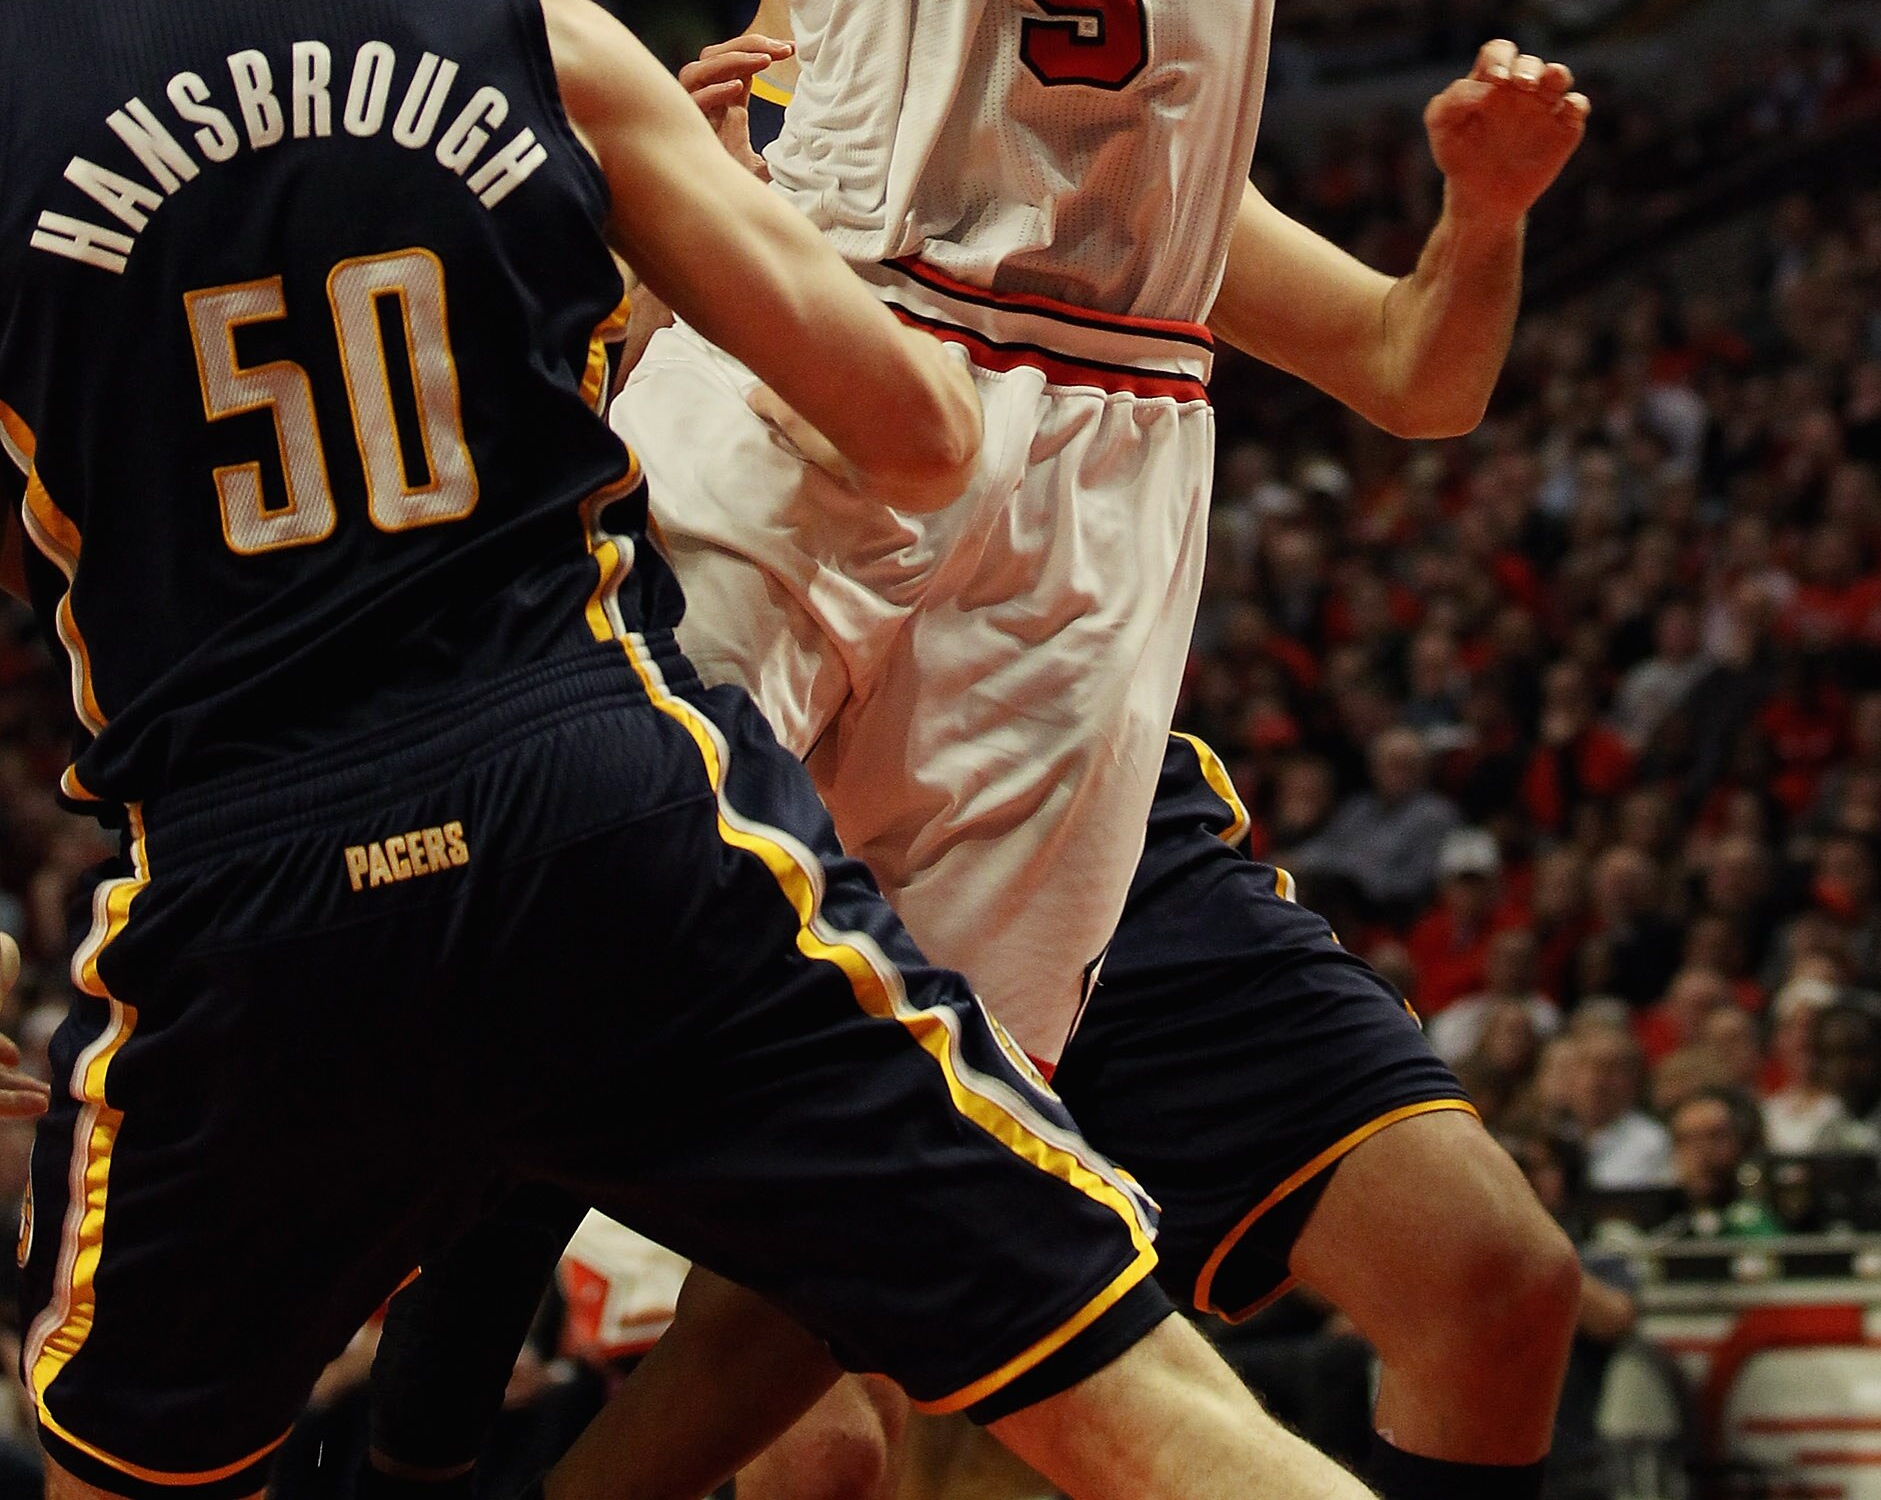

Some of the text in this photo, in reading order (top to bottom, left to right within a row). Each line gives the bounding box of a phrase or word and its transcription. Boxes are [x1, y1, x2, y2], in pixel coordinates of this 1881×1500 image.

[30, 40, 548, 274] HANSBROUGH
[183, 246, 480, 556] 50
[344, 820, 469, 892] PACERS
